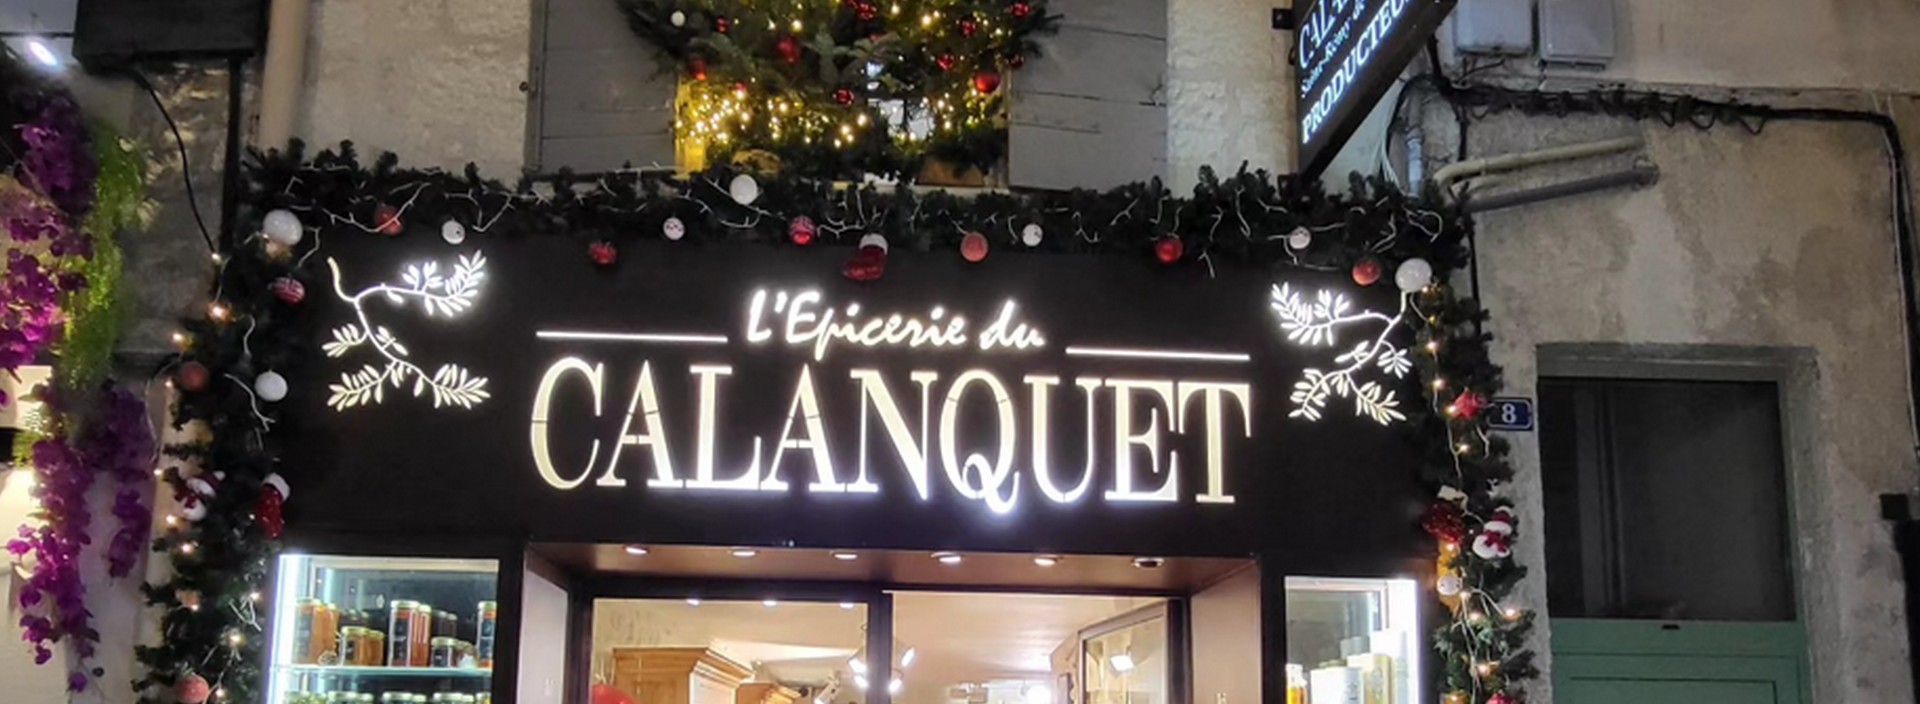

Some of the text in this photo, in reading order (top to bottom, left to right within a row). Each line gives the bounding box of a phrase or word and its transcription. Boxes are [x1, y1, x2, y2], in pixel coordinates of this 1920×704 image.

[1302, 0, 1411, 144] PRODUCTEU
[745, 288, 1047, 362] L'Epicerie du
[530, 355, 1252, 515] CALANQUET
[1501, 403, 1517, 424] 8
